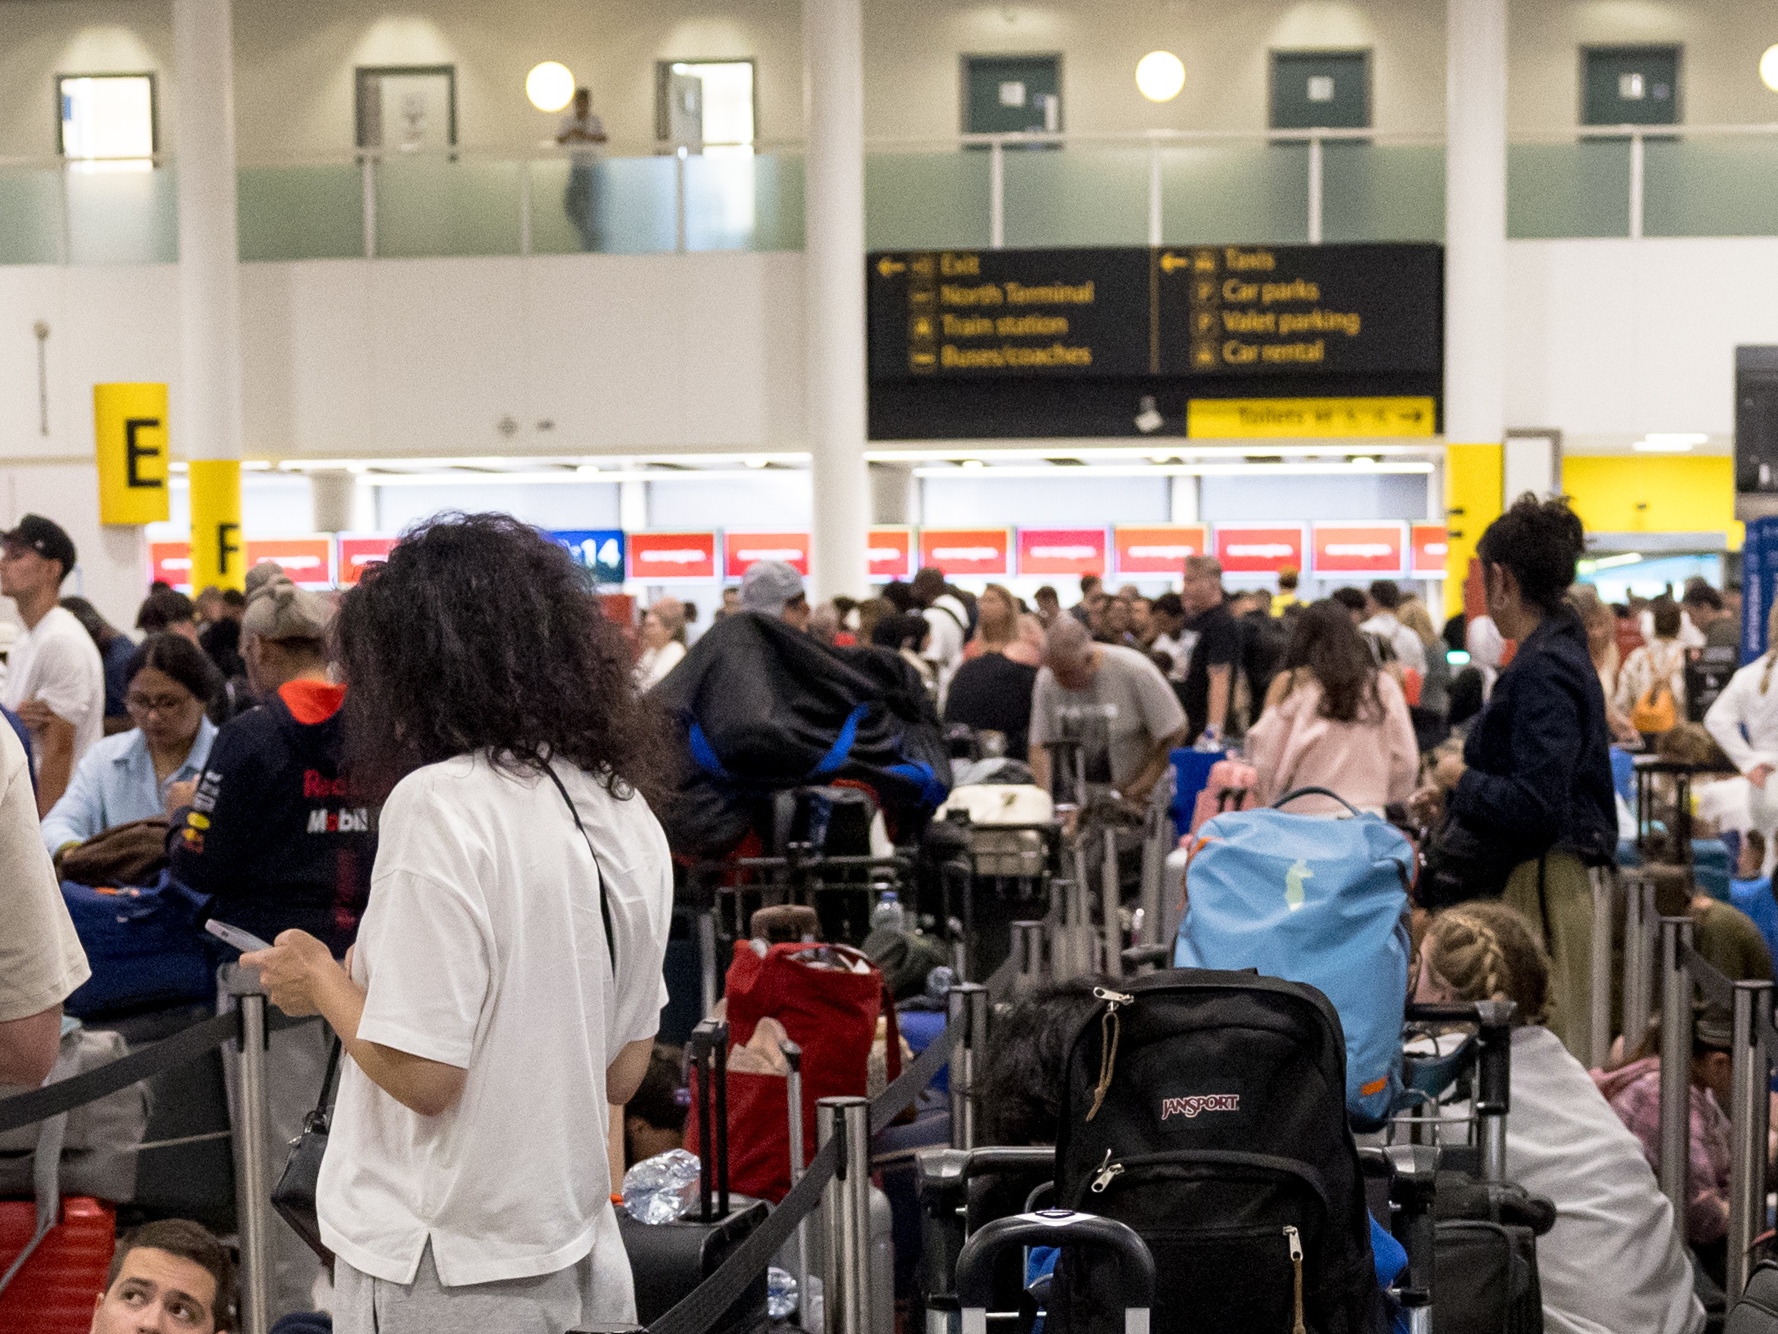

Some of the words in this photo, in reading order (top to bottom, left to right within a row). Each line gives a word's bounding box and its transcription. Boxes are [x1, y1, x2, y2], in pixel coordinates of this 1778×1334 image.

[940, 250, 980, 275] Exit
[1223, 278, 1259, 302] Car
[1261, 277, 1320, 304] parks
[1223, 310, 1276, 333] Valet
[1278, 308, 1361, 336] parking
[1223, 339, 1259, 363] Car
[1261, 339, 1325, 362] rental
[125, 417, 162, 489] E
[217, 521, 239, 575] F
[1162, 1094, 1239, 1120] JANSPORT
